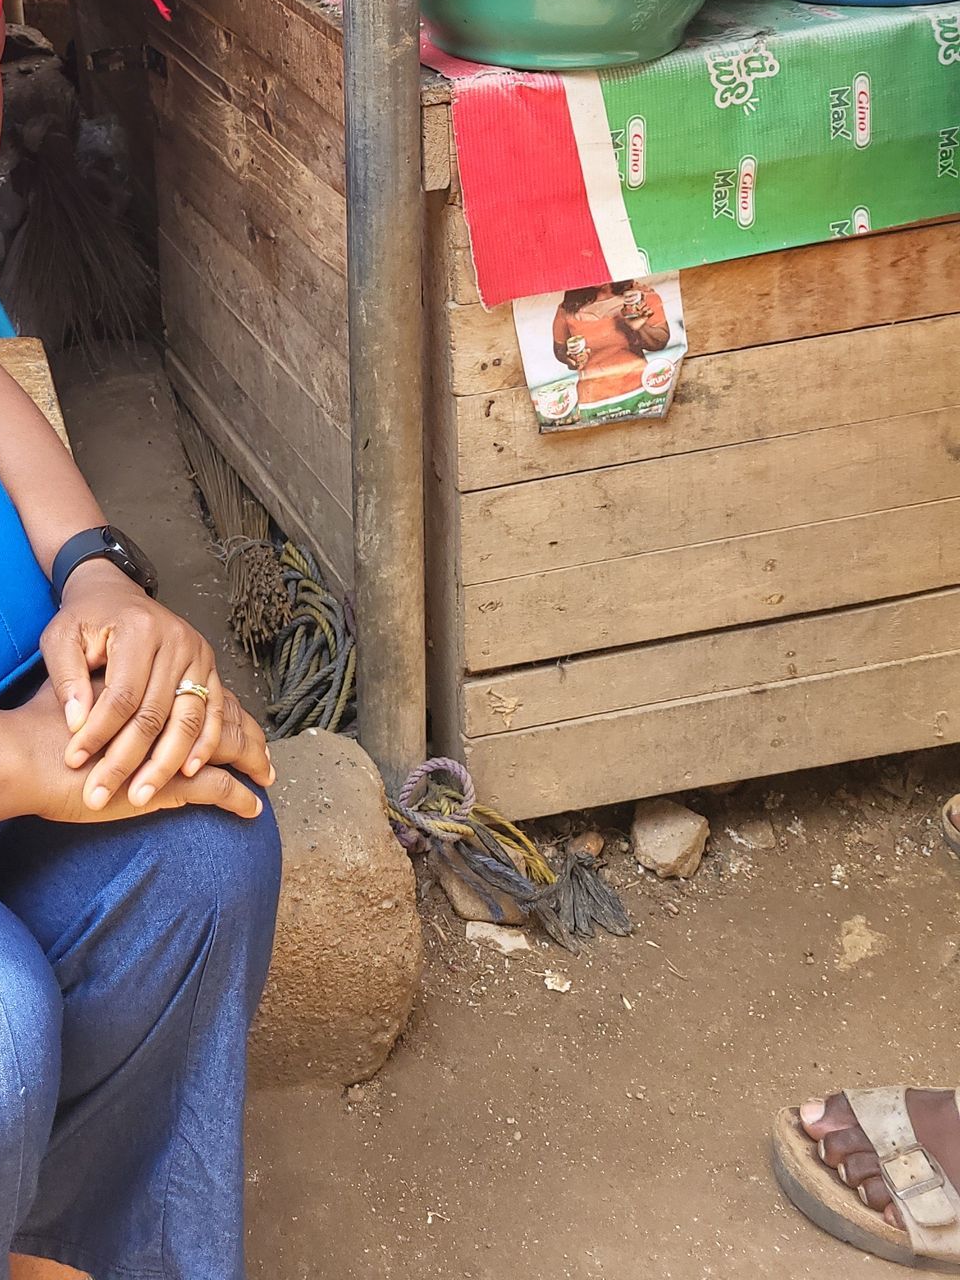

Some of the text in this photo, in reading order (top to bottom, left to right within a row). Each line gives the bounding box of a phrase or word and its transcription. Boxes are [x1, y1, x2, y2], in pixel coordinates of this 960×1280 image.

[857, 90, 869, 132] Gino
[631, 133, 643, 174] Gino
[740, 172, 753, 211] Gino
